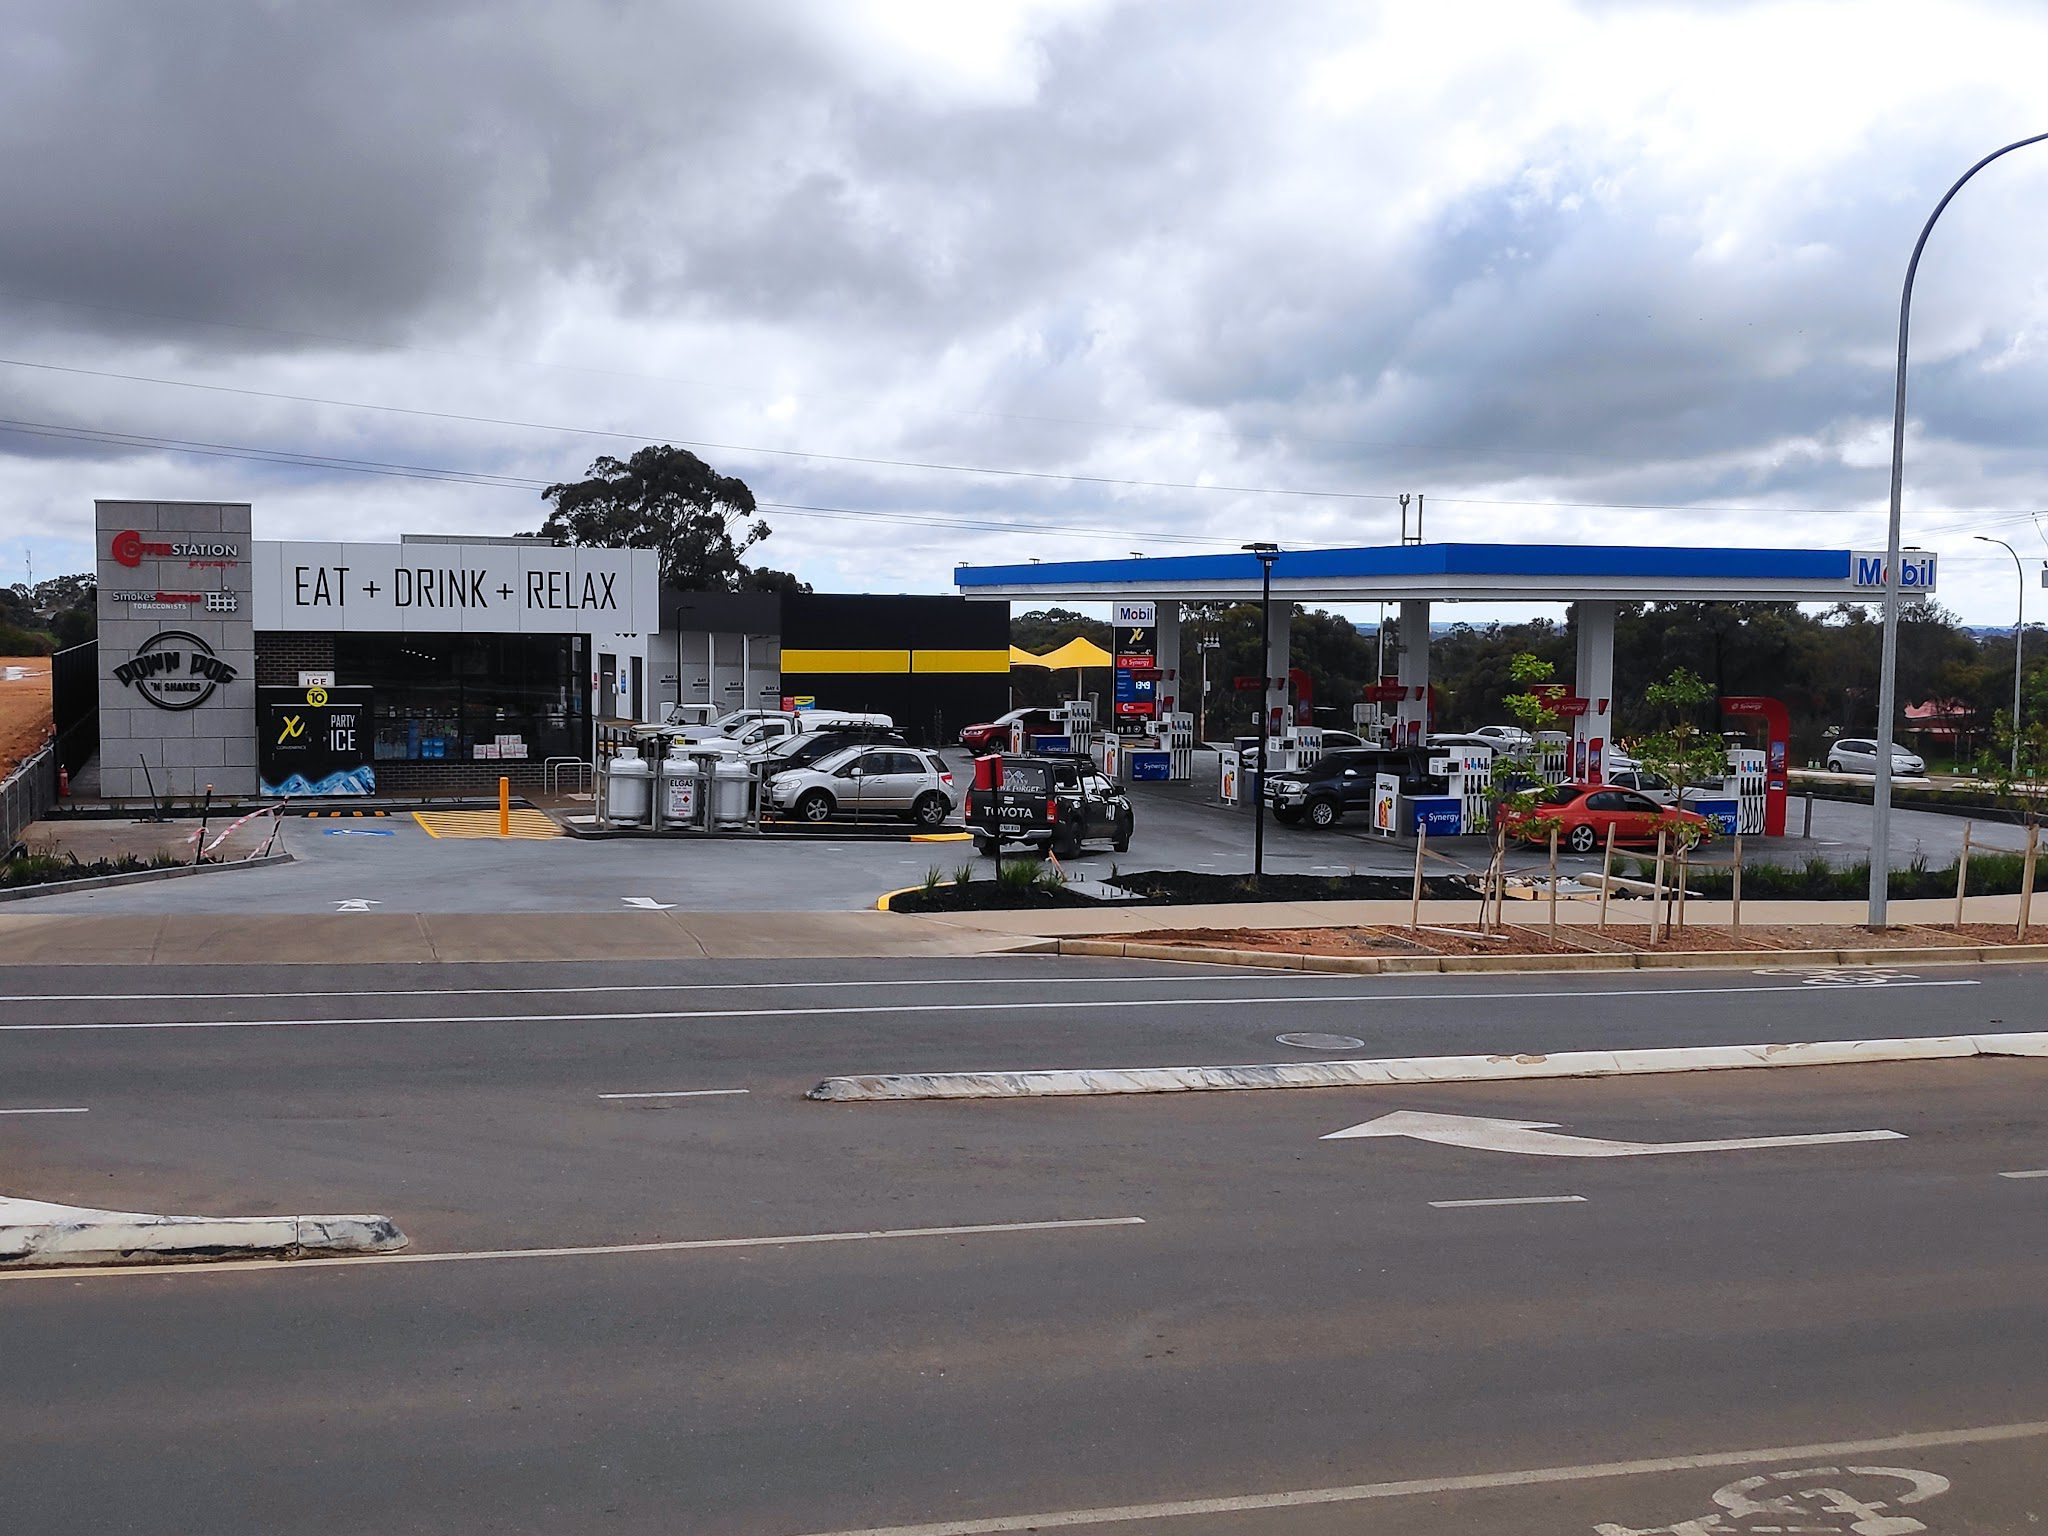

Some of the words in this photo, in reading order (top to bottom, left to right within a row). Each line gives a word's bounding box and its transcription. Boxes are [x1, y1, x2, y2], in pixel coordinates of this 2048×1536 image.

[1858, 558, 1934, 586] Mbil
[294, 566, 350, 607] EAT
[394, 568, 488, 609] DRINK
[526, 570, 617, 610] RELAX
[133, 602, 187, 610] TOBACCONISTS
[1120, 607, 1153, 620] Mobil
[112, 651, 180, 688] DOWN
[189, 652, 238, 684] DOG
[164, 682, 201, 692] SHAKES
[306, 678, 327, 686] ICE
[330, 714, 356, 728] PARTY
[330, 729, 357, 752] ICE
[1143, 762, 1168, 771] Synergy
[670, 779, 693, 787] ELGAS
[983, 805, 1034, 818] TOYOTA
[1428, 812, 1460, 823] Synergy
